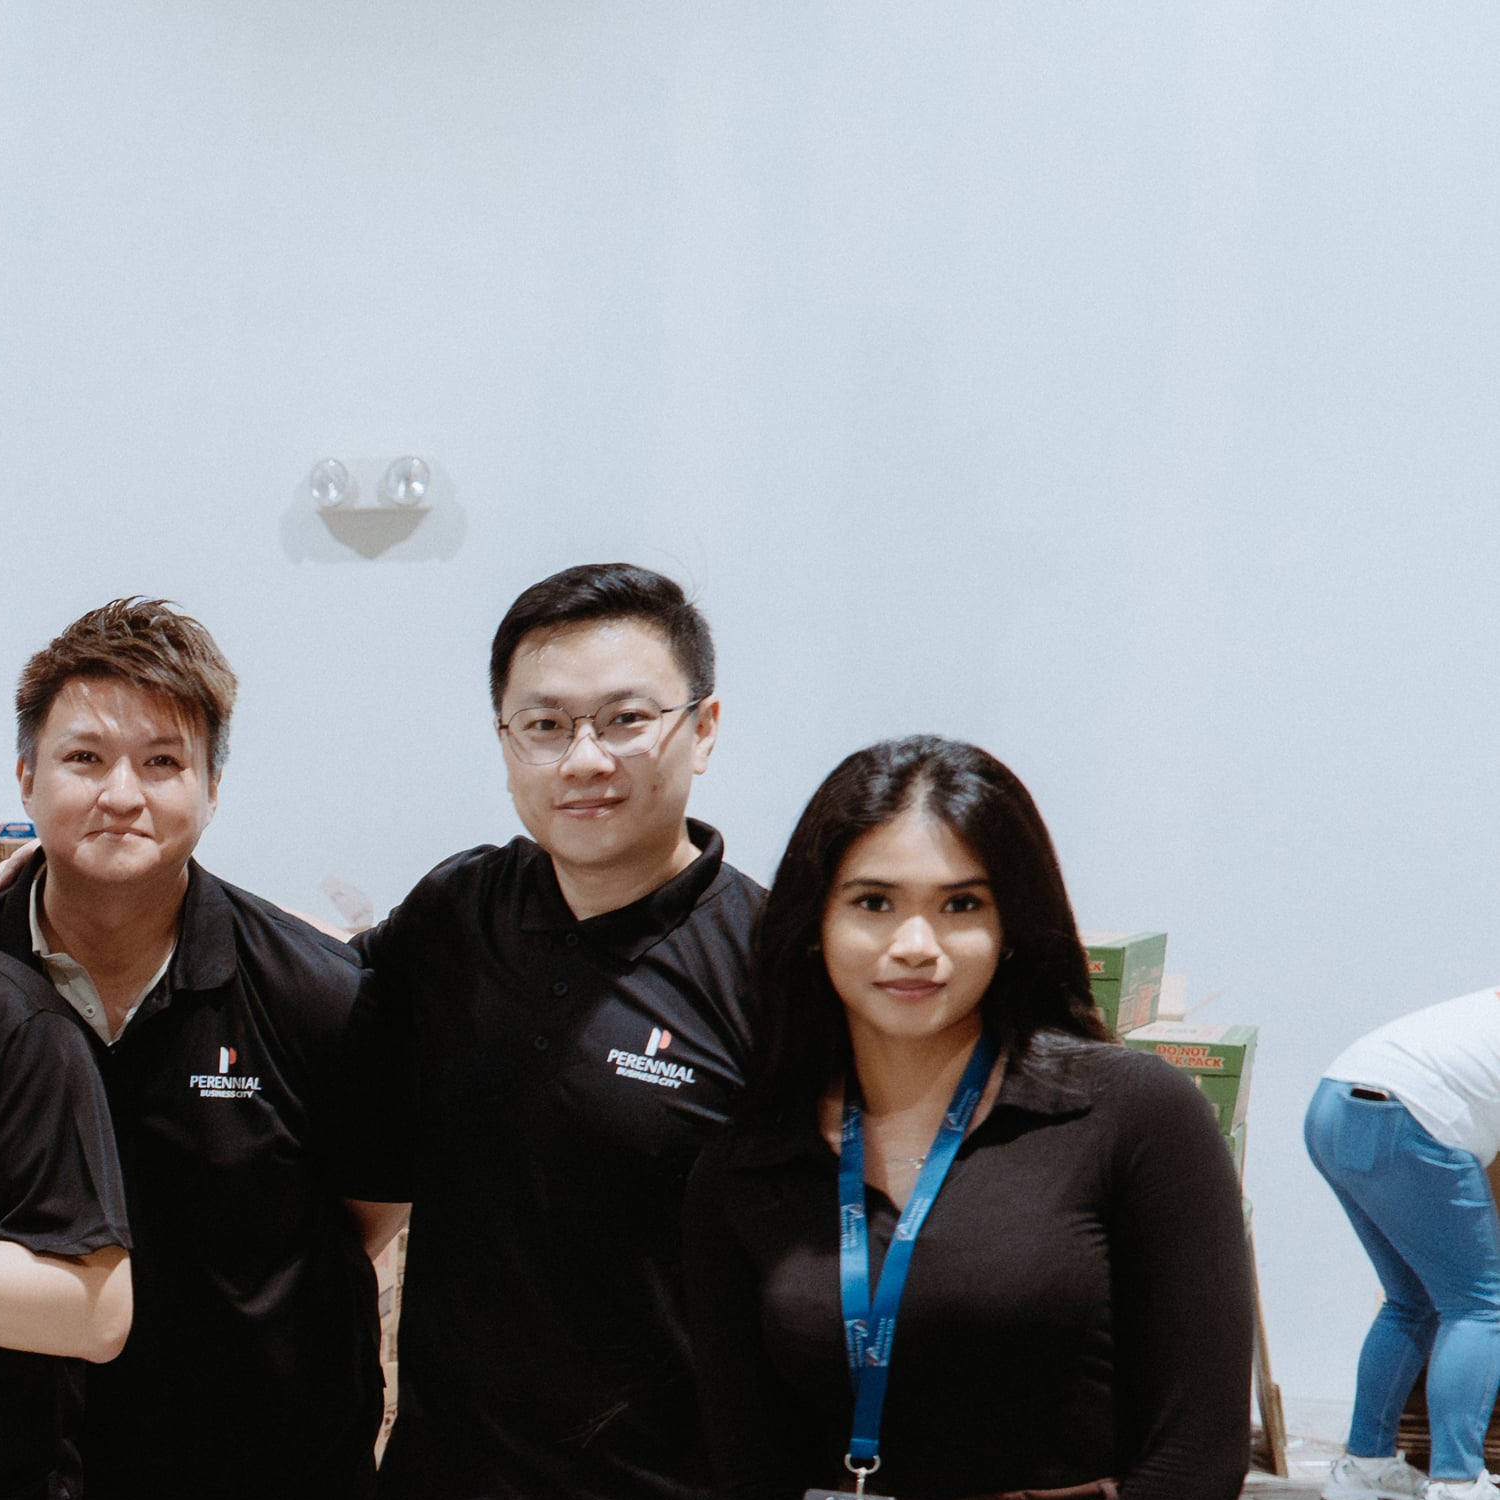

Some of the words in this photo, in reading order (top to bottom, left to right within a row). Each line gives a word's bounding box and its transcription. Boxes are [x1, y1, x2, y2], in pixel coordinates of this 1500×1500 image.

[1181, 1046, 1208, 1057] NOT
[606, 1048, 696, 1084] PERENNIAL
[1187, 1057, 1223, 1068] PACK
[189, 1075, 263, 1090] PERENNIAL
[658, 1077, 682, 1089] CITY
[200, 1089, 236, 1098] BUSINESS
[236, 1090, 255, 1098] CITY
